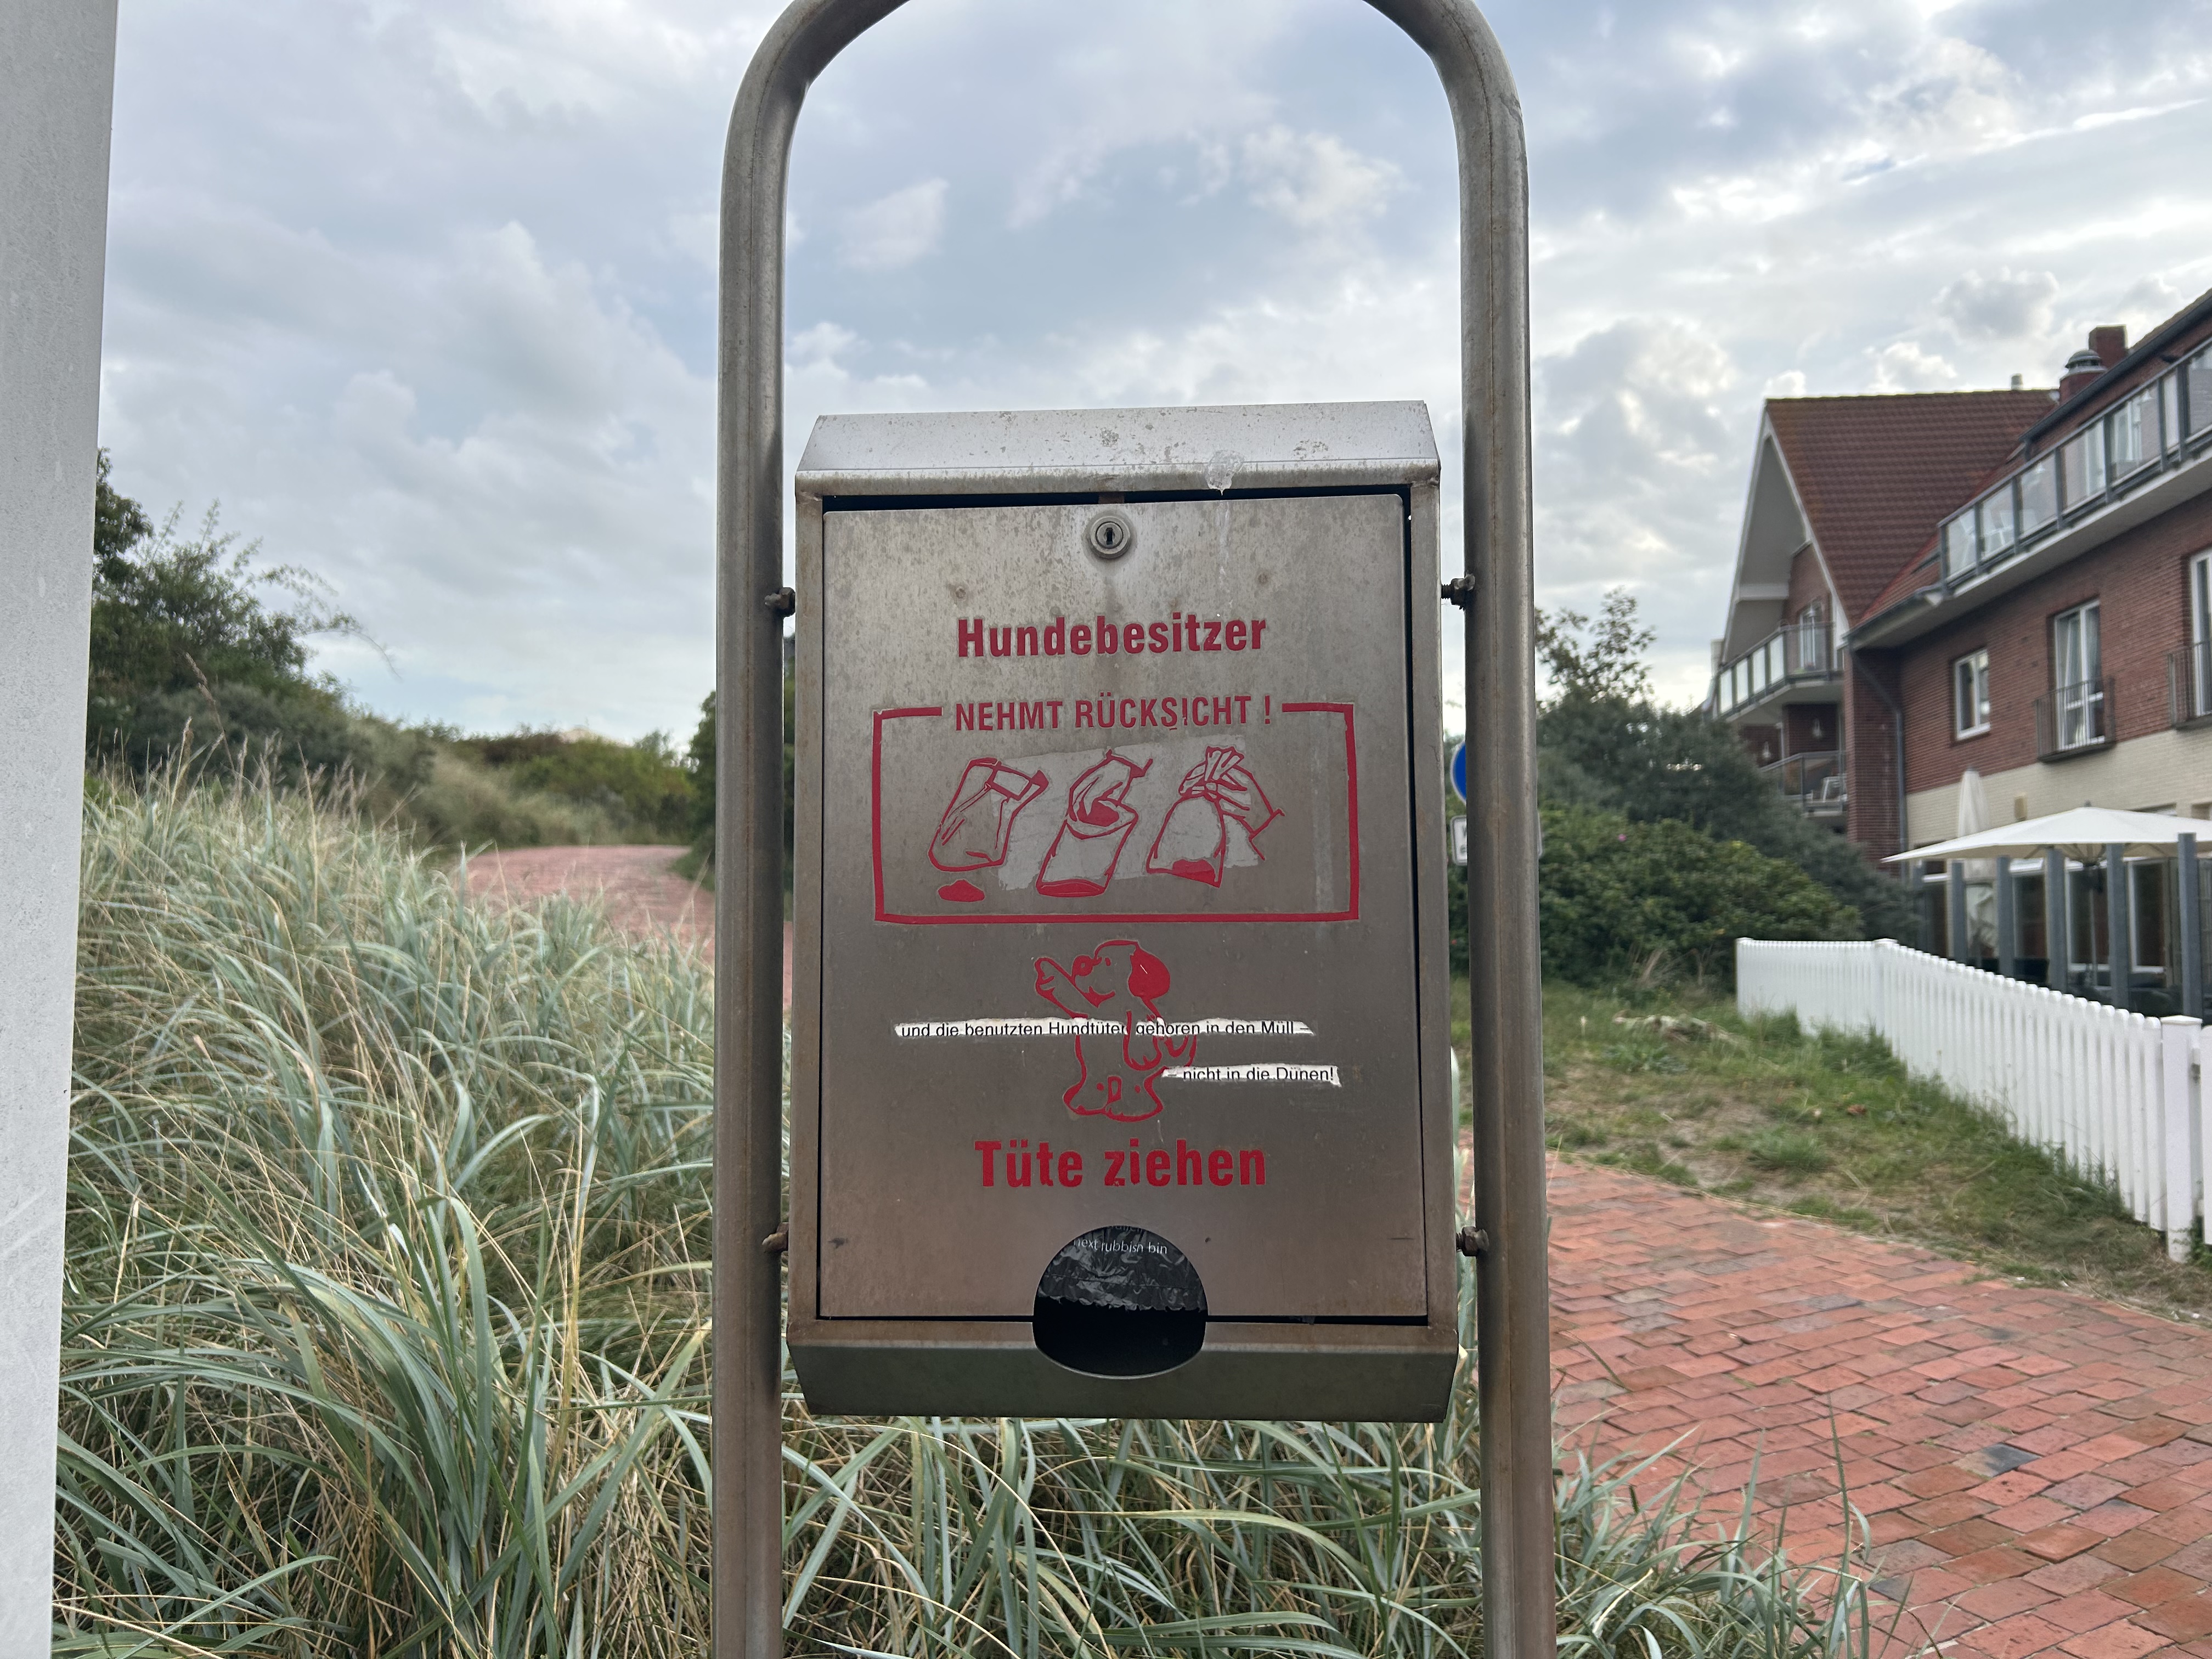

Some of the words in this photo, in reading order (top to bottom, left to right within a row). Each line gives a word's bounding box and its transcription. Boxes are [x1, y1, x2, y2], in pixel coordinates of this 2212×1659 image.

[958, 612, 1266, 657] Hundebesitzer
[956, 701, 1063, 731] NEHMT
[1076, 692, 1251, 731] RÜCKSICHT
[901, 1023, 930, 1036] und
[936, 1023, 959, 1036] die
[966, 1023, 1042, 1036] benutzten
[1207, 1021, 1219, 1034] in
[1226, 1021, 1255, 1034] den
[1262, 1020, 1294, 1034] Müll
[1183, 1068, 1221, 1080] nicht
[1227, 1068, 1240, 1080] in
[1246, 1067, 1269, 1080] die
[1277, 1066, 1333, 1081] Dünen!
[974, 1139, 1083, 1188] Tüte
[1104, 1138, 1266, 1187] ziehen
[1101, 1239, 1143, 1253] rubbish
[1148, 1242, 1167, 1255] bin
